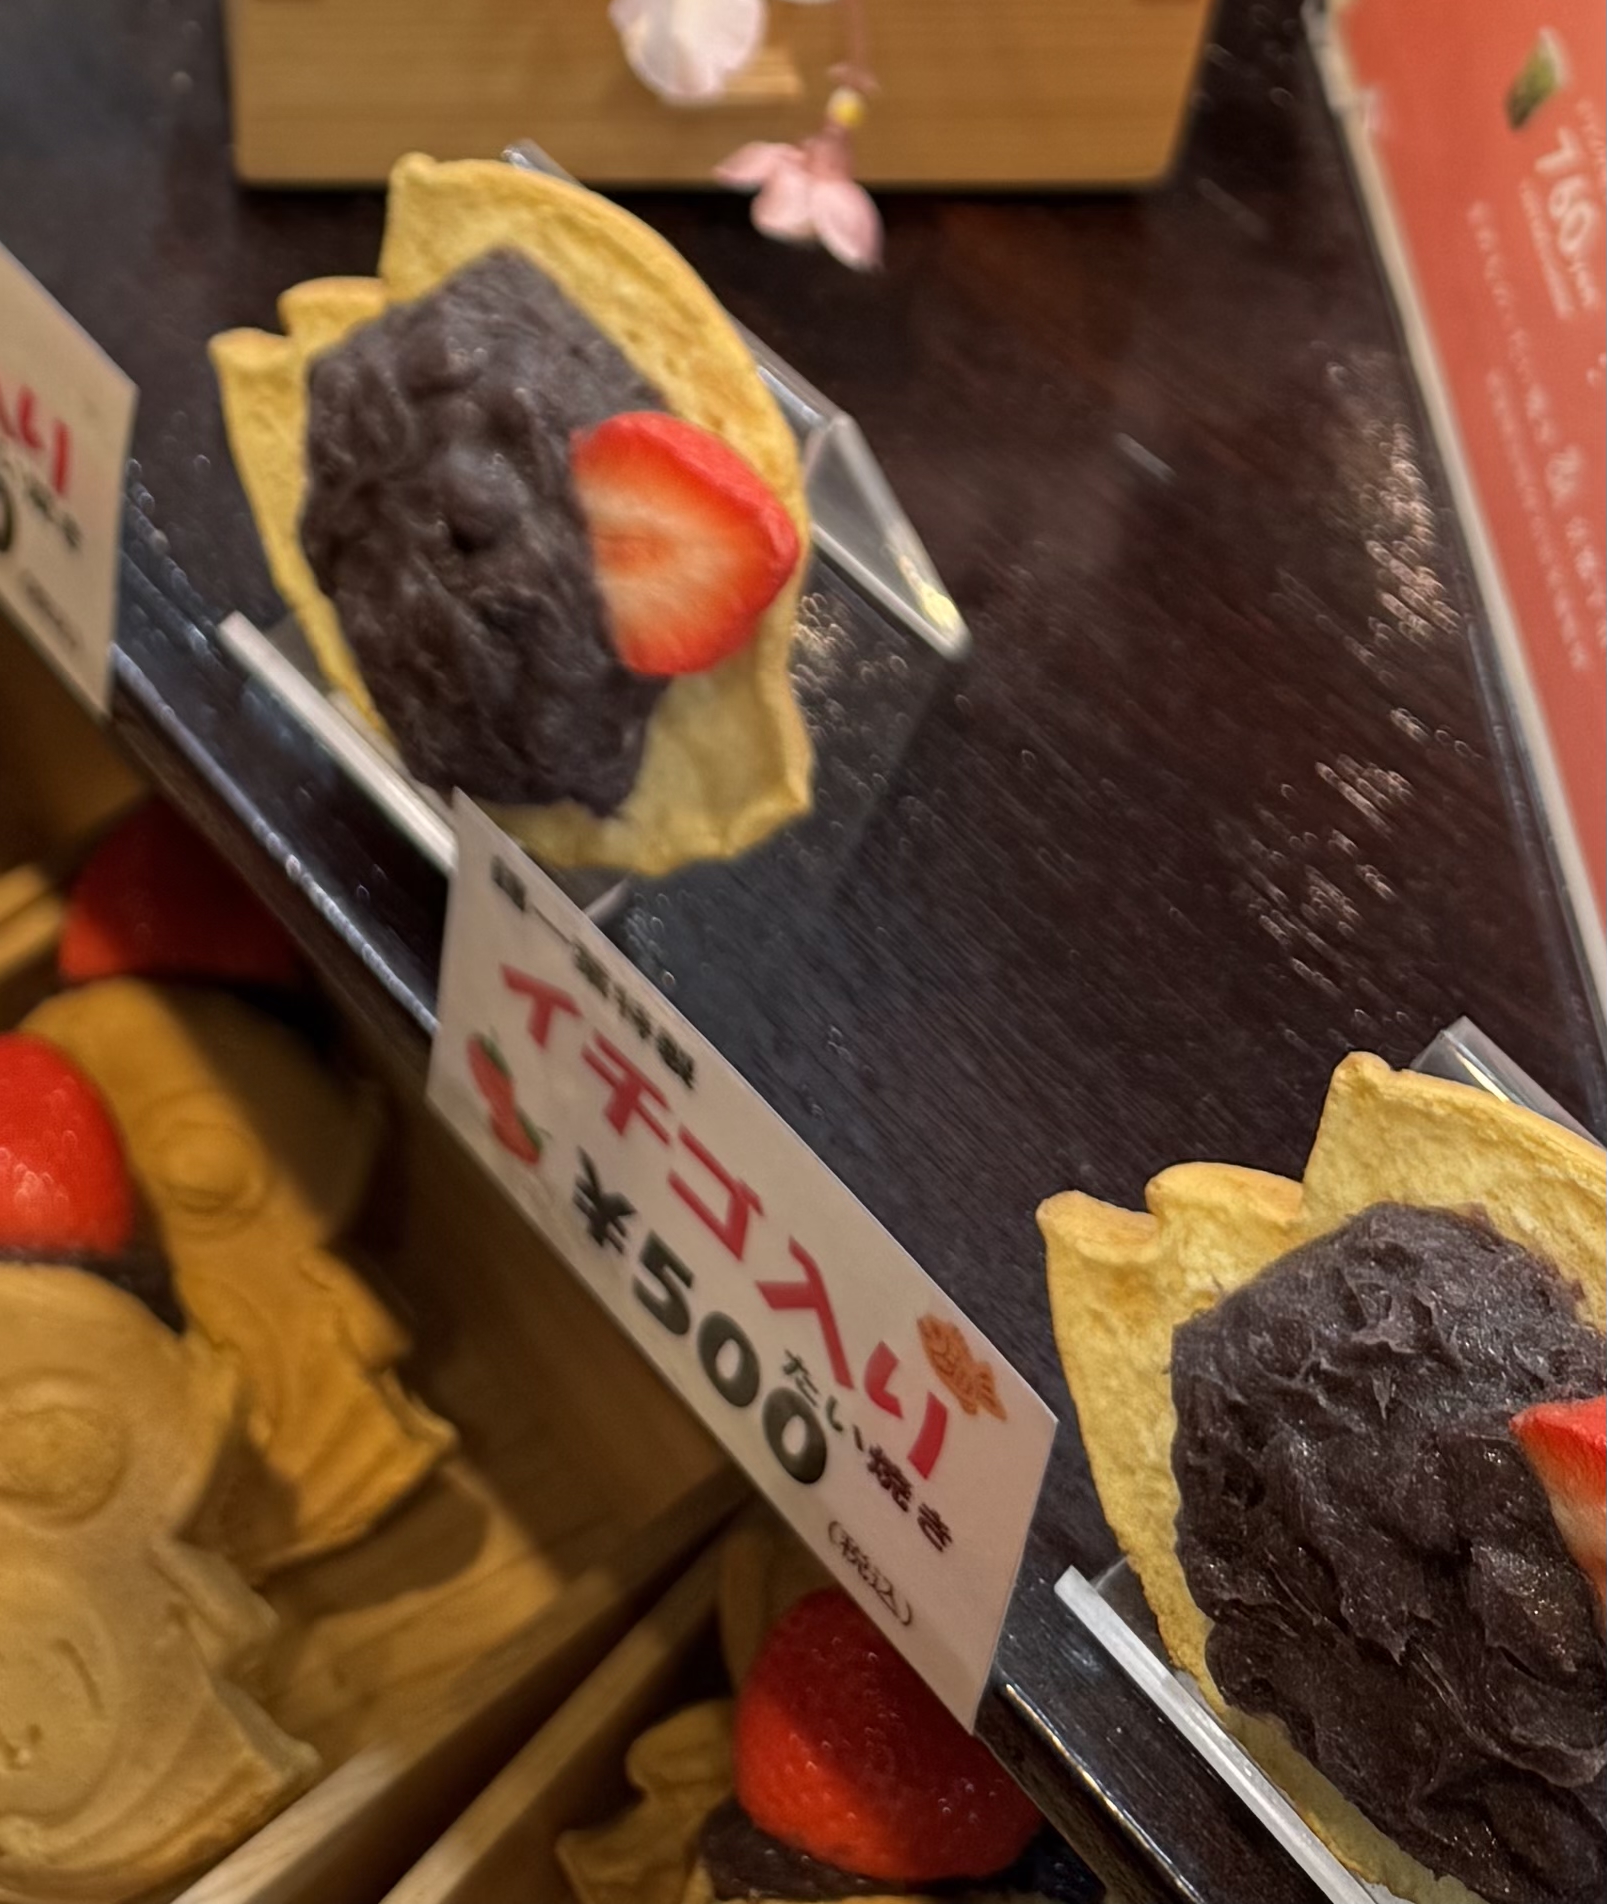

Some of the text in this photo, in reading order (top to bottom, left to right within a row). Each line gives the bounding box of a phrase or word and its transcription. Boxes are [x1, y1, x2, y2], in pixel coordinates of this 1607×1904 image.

[498, 961, 949, 1482] イチゴ入り
[570, 1147, 830, 1487] ¥500
[778, 1348, 956, 1553] たい焼き
[825, 1517, 916, 1629] (税込)
